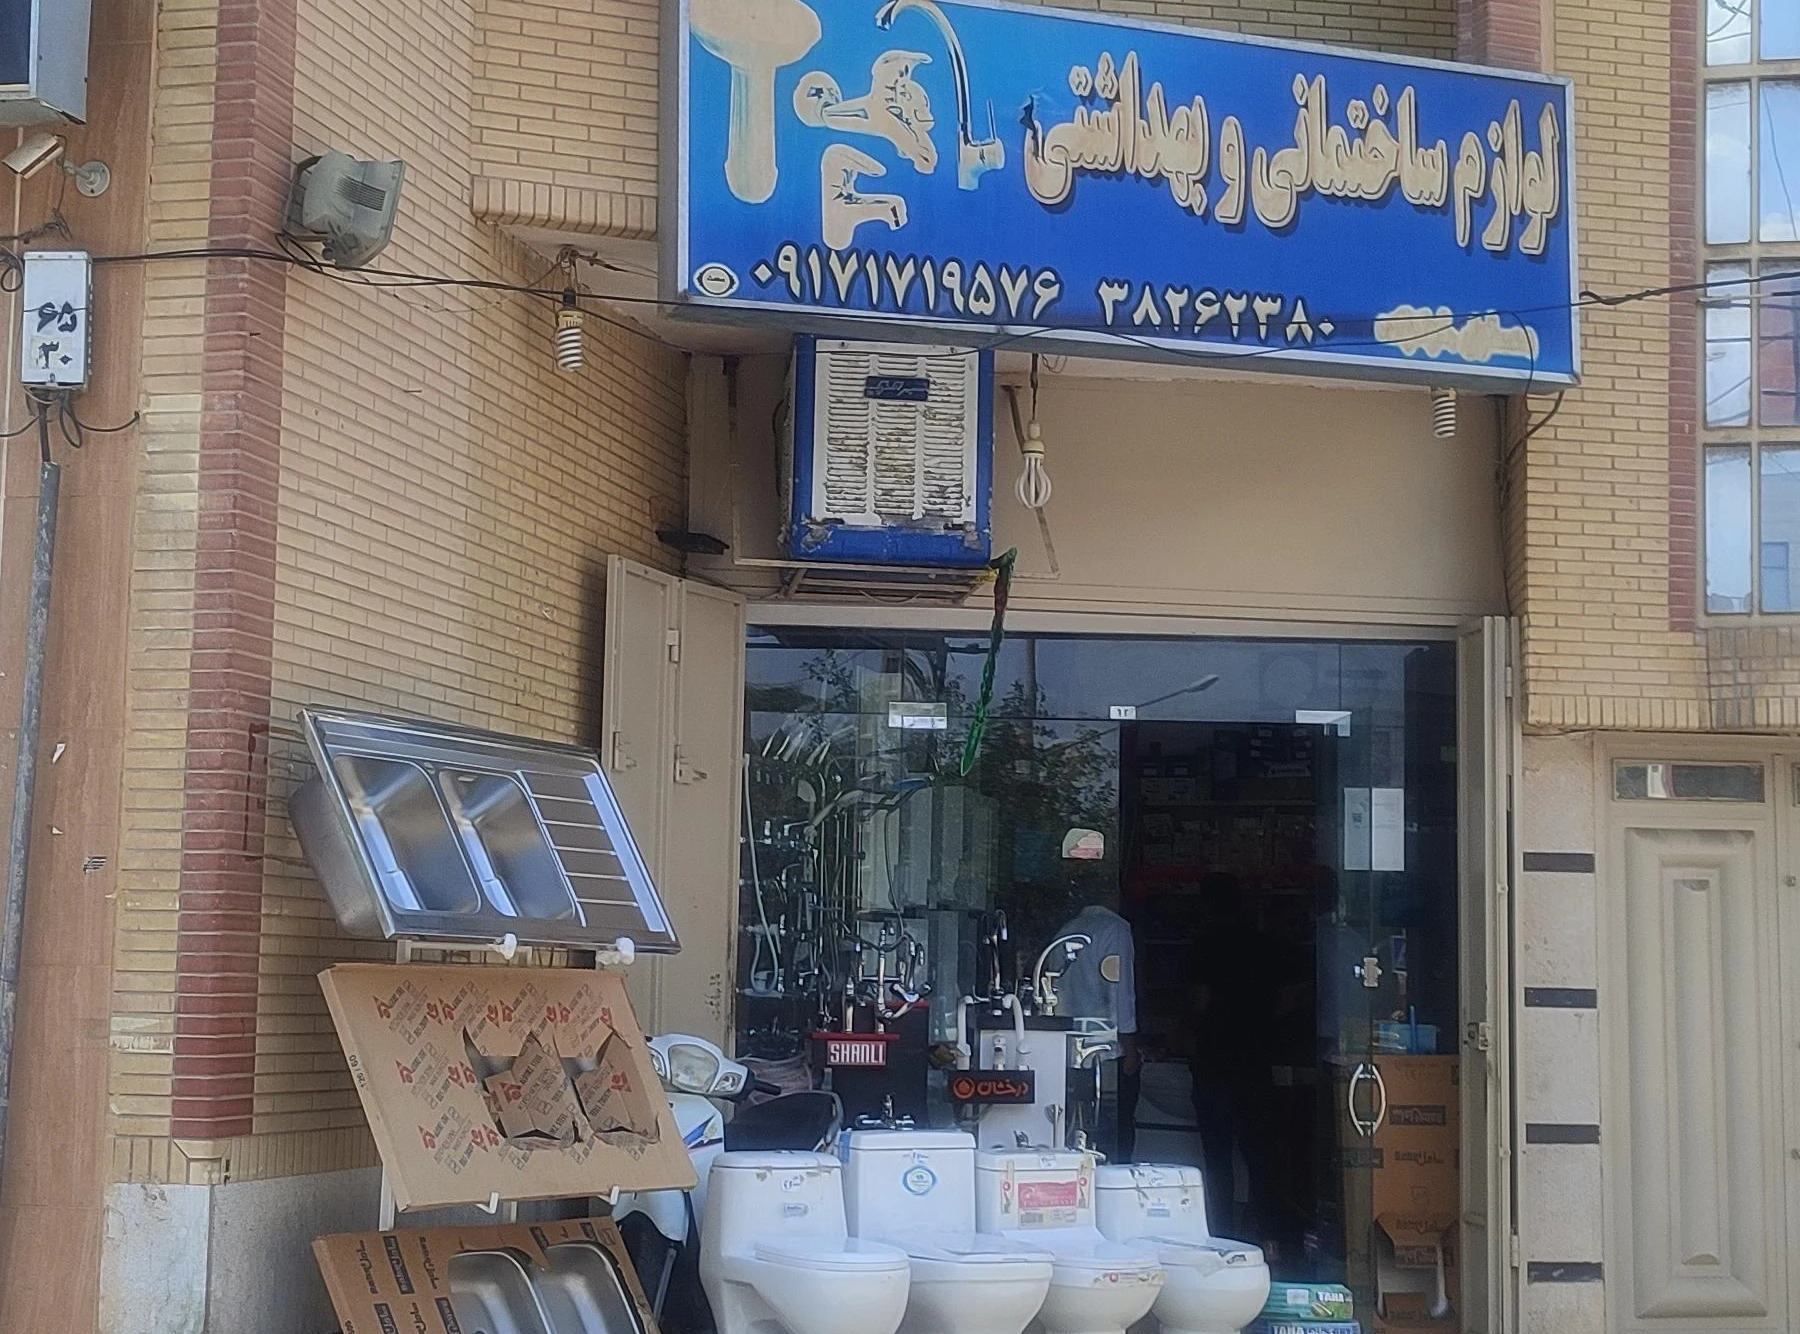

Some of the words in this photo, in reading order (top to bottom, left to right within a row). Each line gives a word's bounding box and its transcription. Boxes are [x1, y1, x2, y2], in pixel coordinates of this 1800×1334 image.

[1024, 50, 1209, 205] بهداشتی
[1214, 115, 1246, 225] و
[1252, 73, 1448, 228] ساختمانی
[1454, 99, 1560, 255] لوازم
[37, 301, 77, 333] ۶۵
[752, 243, 1062, 320] ۰۹۱۷۱۷۱۹۵۷۶
[1097, 279, 1337, 345] ۳۸۲۶۲۳۸۰
[829, 1042, 884, 1063] SHANLI
[977, 1078, 1029, 1097] درخشان
